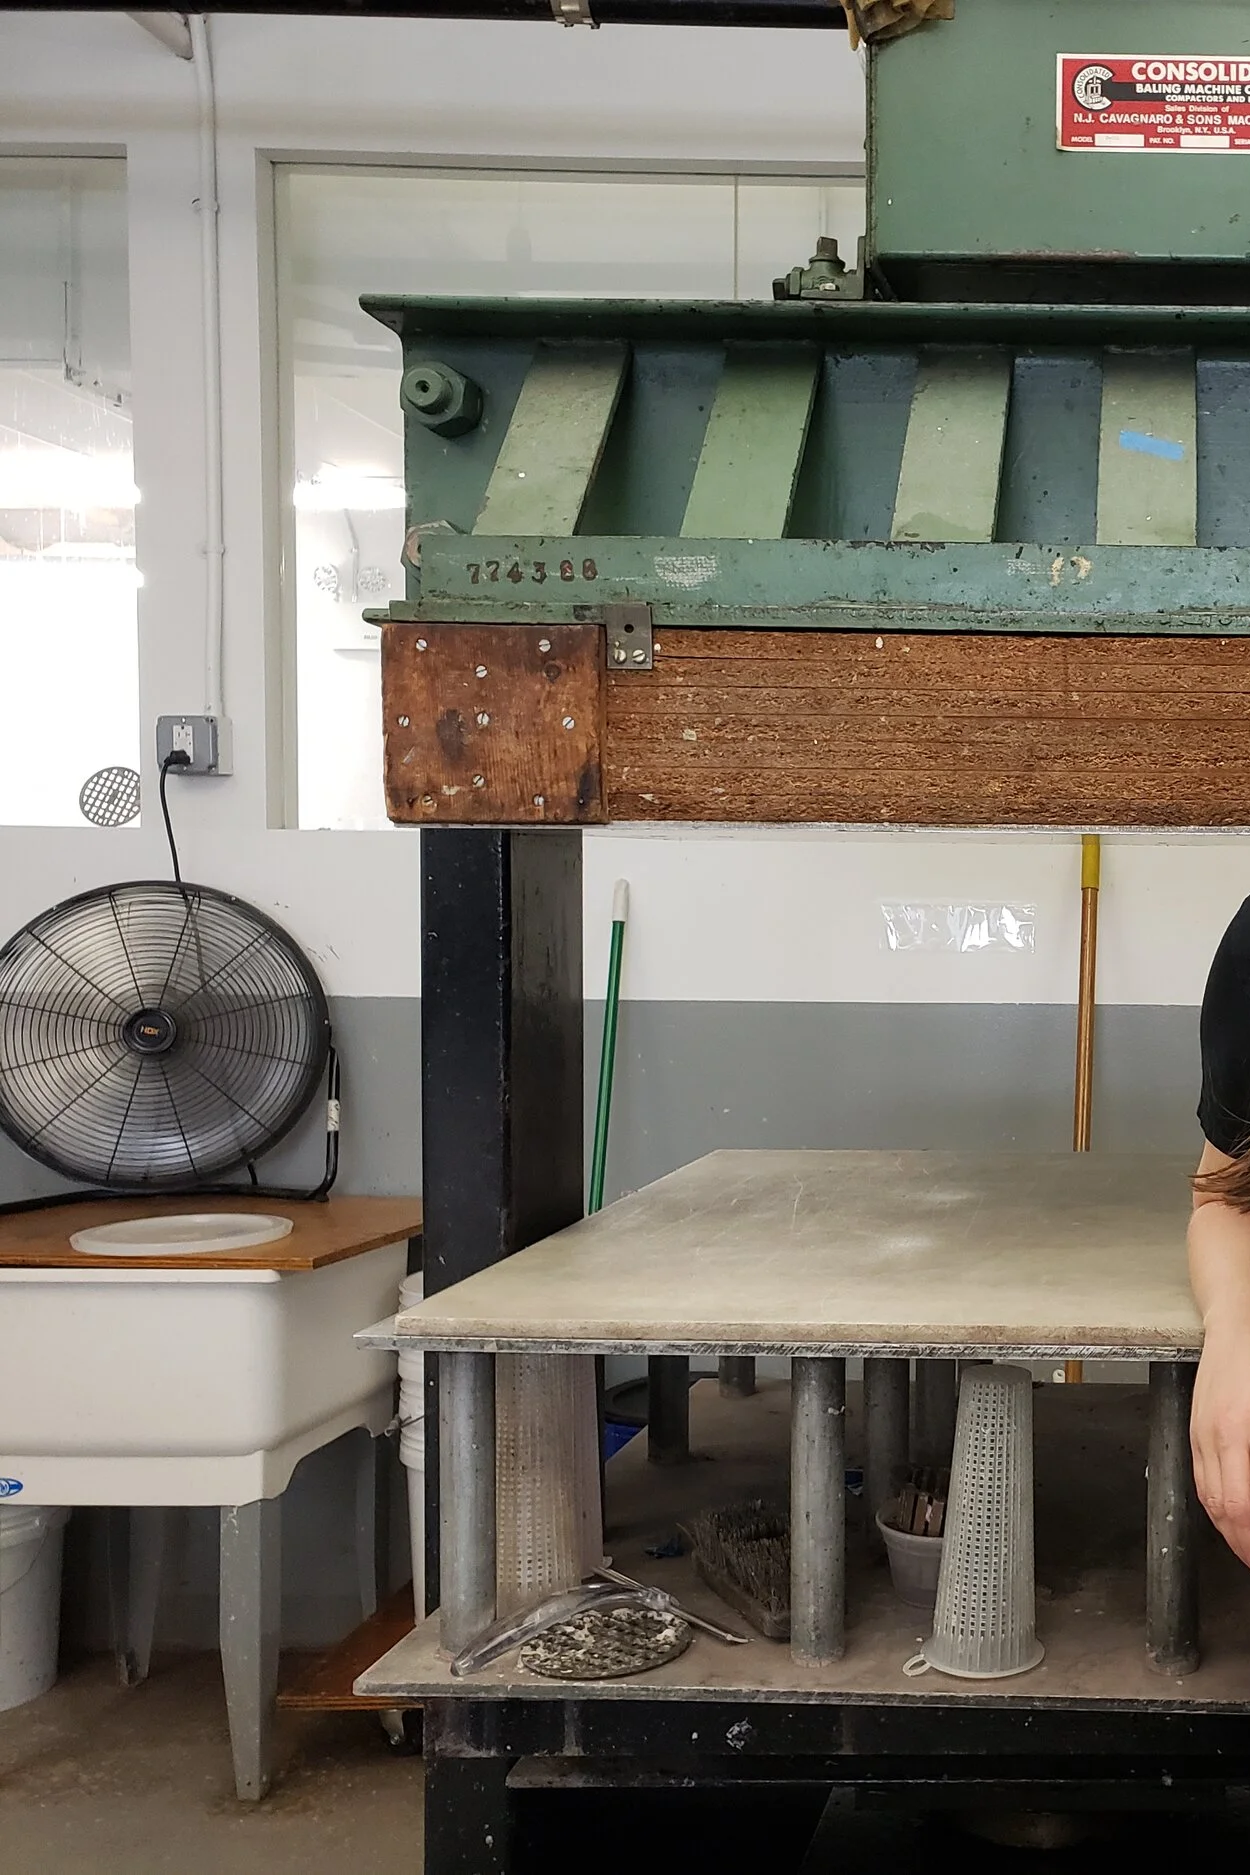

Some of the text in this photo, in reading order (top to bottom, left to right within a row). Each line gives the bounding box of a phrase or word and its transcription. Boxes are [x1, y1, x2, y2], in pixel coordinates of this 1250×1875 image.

[1135, 83, 1181, 94] BALING
[1183, 83, 1242, 95] MACHINE
[1165, 94, 1224, 103] COMPACTORS
[1226, 95, 1246, 103] AND
[1165, 104, 1186, 112] Sales
[1188, 104, 1218, 112] Division
[1073, 113, 1095, 123] N.J.
[1100, 113, 1173, 124] CAVAGNARO
[1175, 114, 1184, 124] &
[1187, 114, 1222, 125] SONS
[1157, 126, 1193, 134] Brooklyn,
